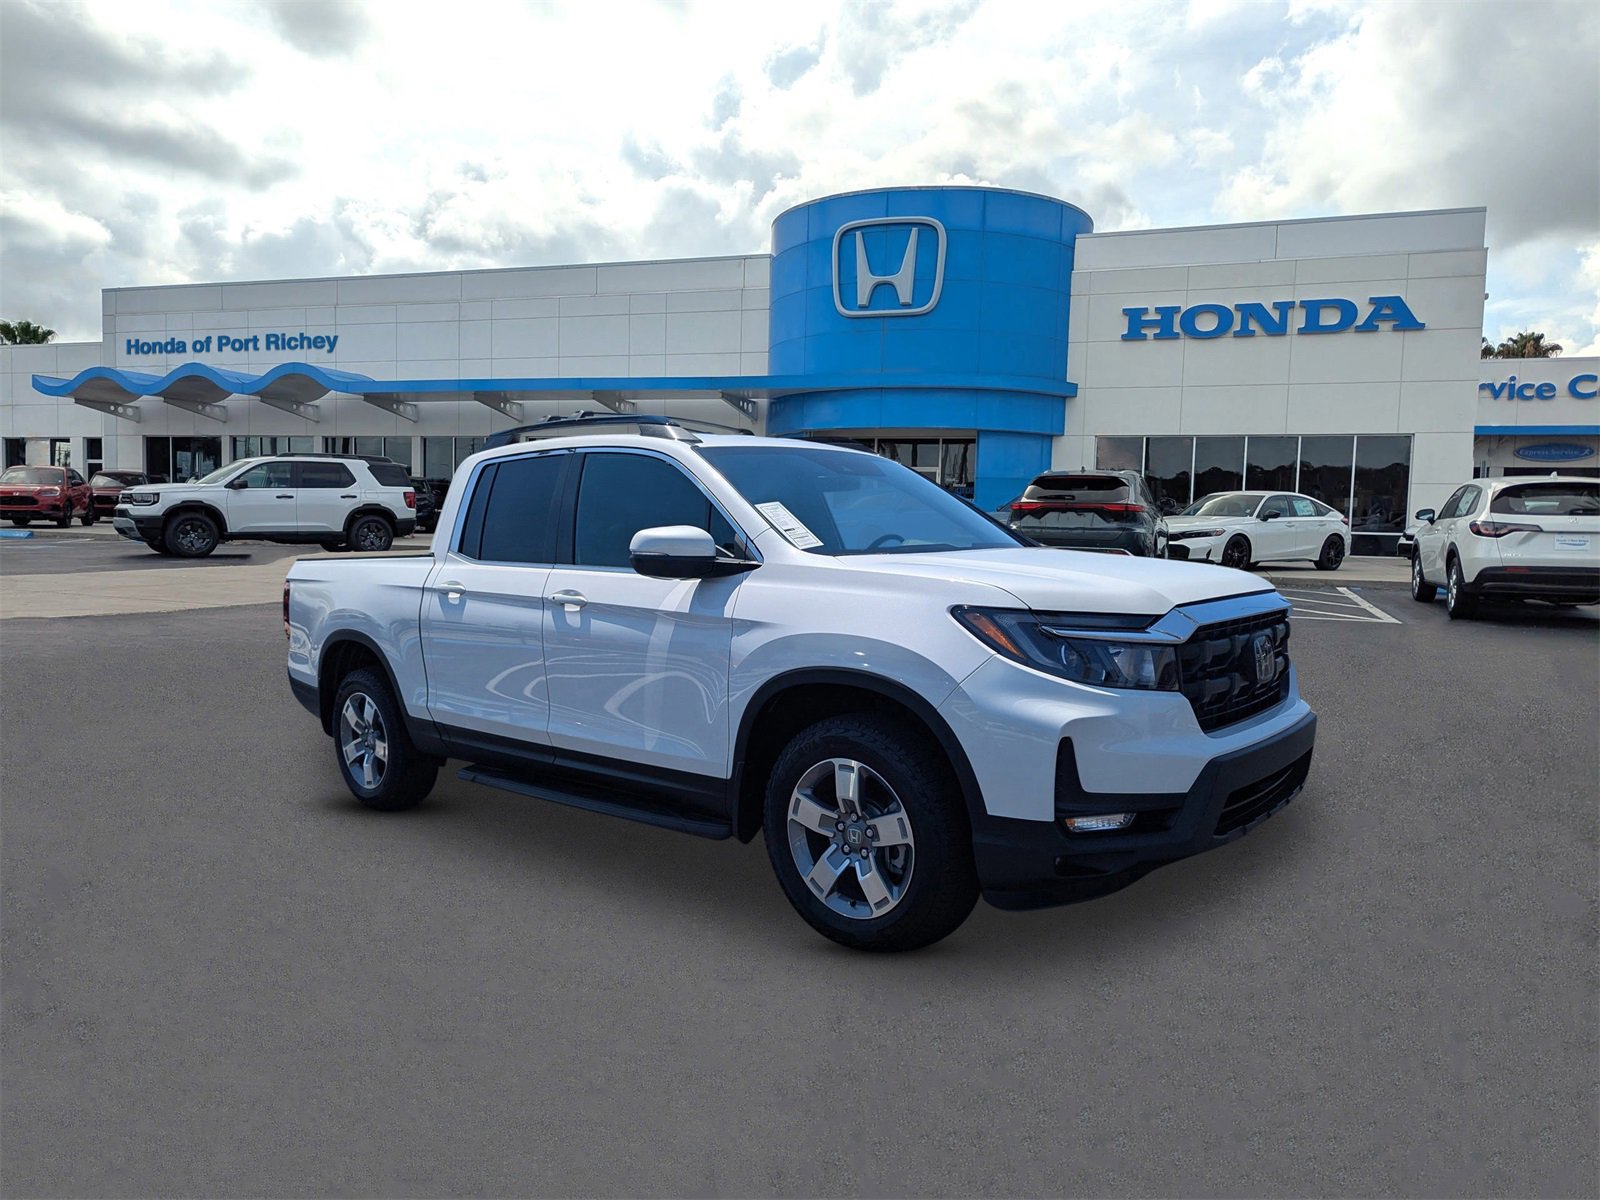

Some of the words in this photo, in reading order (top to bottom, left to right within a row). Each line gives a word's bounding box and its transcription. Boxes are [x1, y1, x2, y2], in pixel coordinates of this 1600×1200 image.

[1121, 296, 1425, 340] HONDA
[126, 337, 187, 355] Honda
[192, 335, 212, 353] of
[217, 334, 260, 352] Port
[265, 332, 338, 353] Richey
[1568, 374, 1600, 399] C
